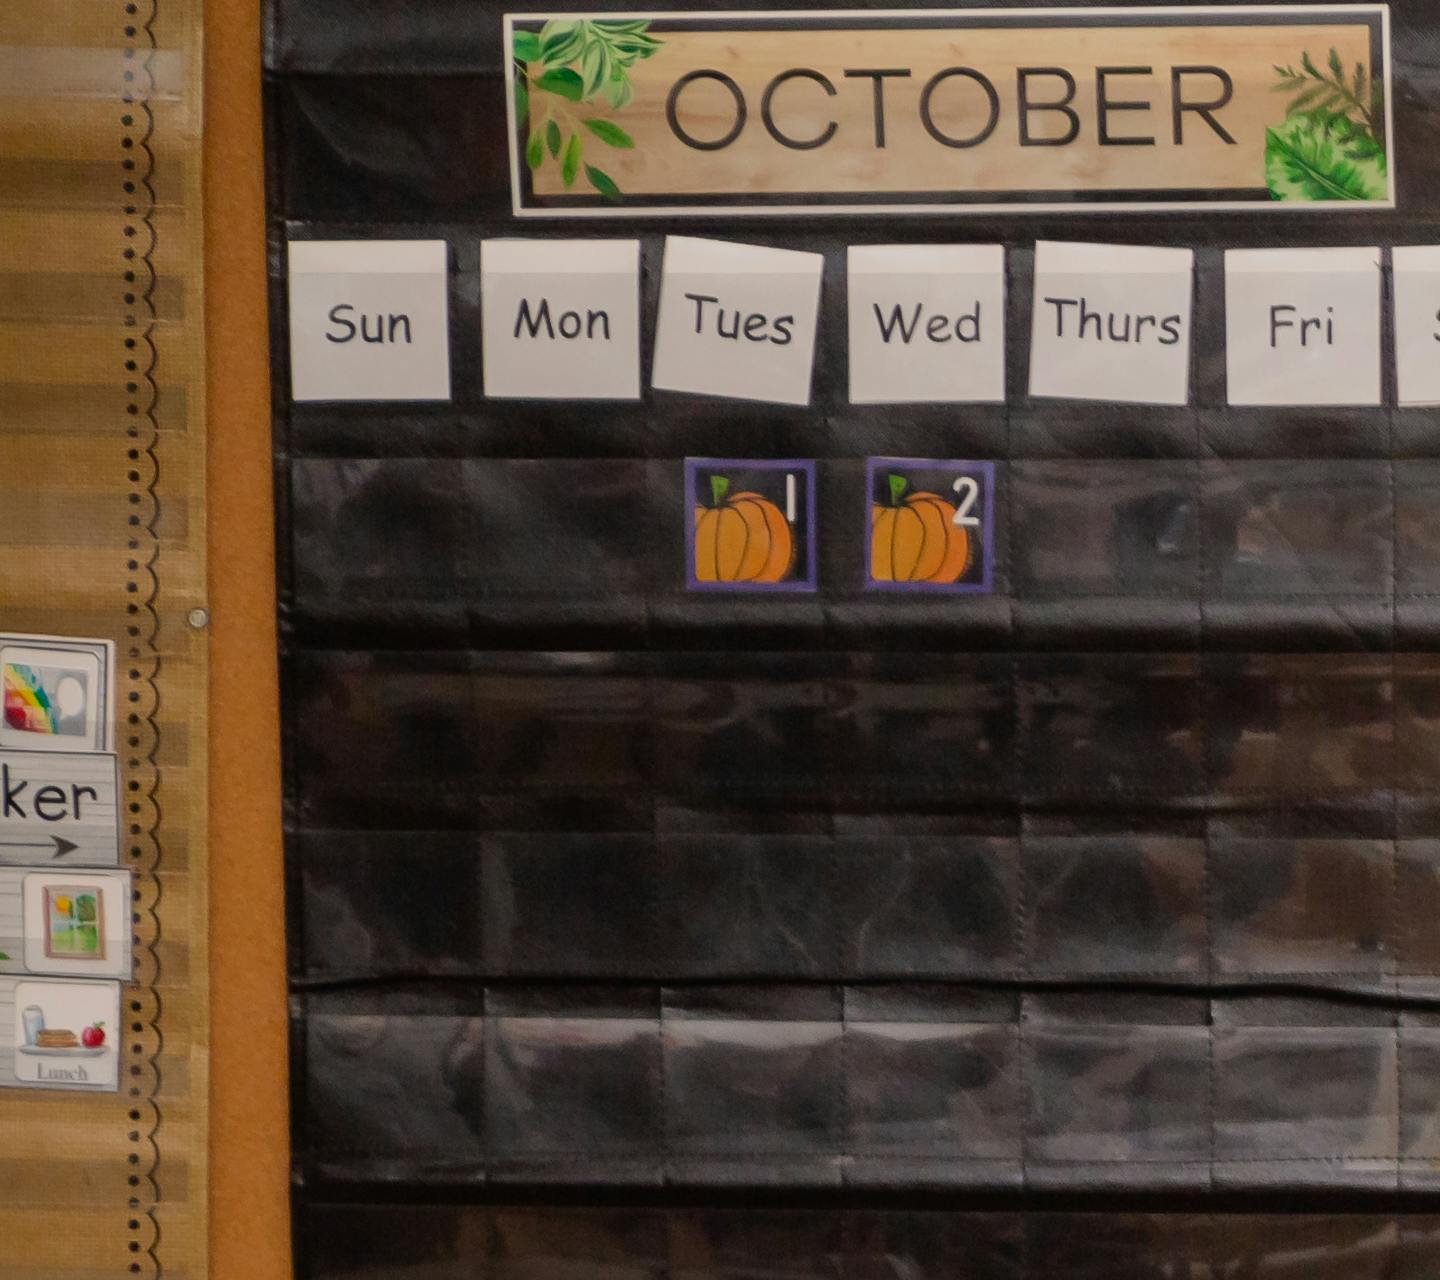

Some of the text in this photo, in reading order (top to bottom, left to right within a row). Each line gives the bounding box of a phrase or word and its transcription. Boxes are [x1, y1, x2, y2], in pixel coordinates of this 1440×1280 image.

[665, 66, 1237, 151] OCTOBER
[324, 304, 412, 345] Sun
[513, 298, 610, 341] Mon
[685, 294, 795, 345] Tues
[873, 300, 981, 343] Wed
[1044, 297, 1181, 346] Thurs
[1269, 306, 1334, 347] Fri
[785, 473, 796, 522] 1
[951, 476, 980, 526] 2
[37, 1063, 88, 1081] Lunch
